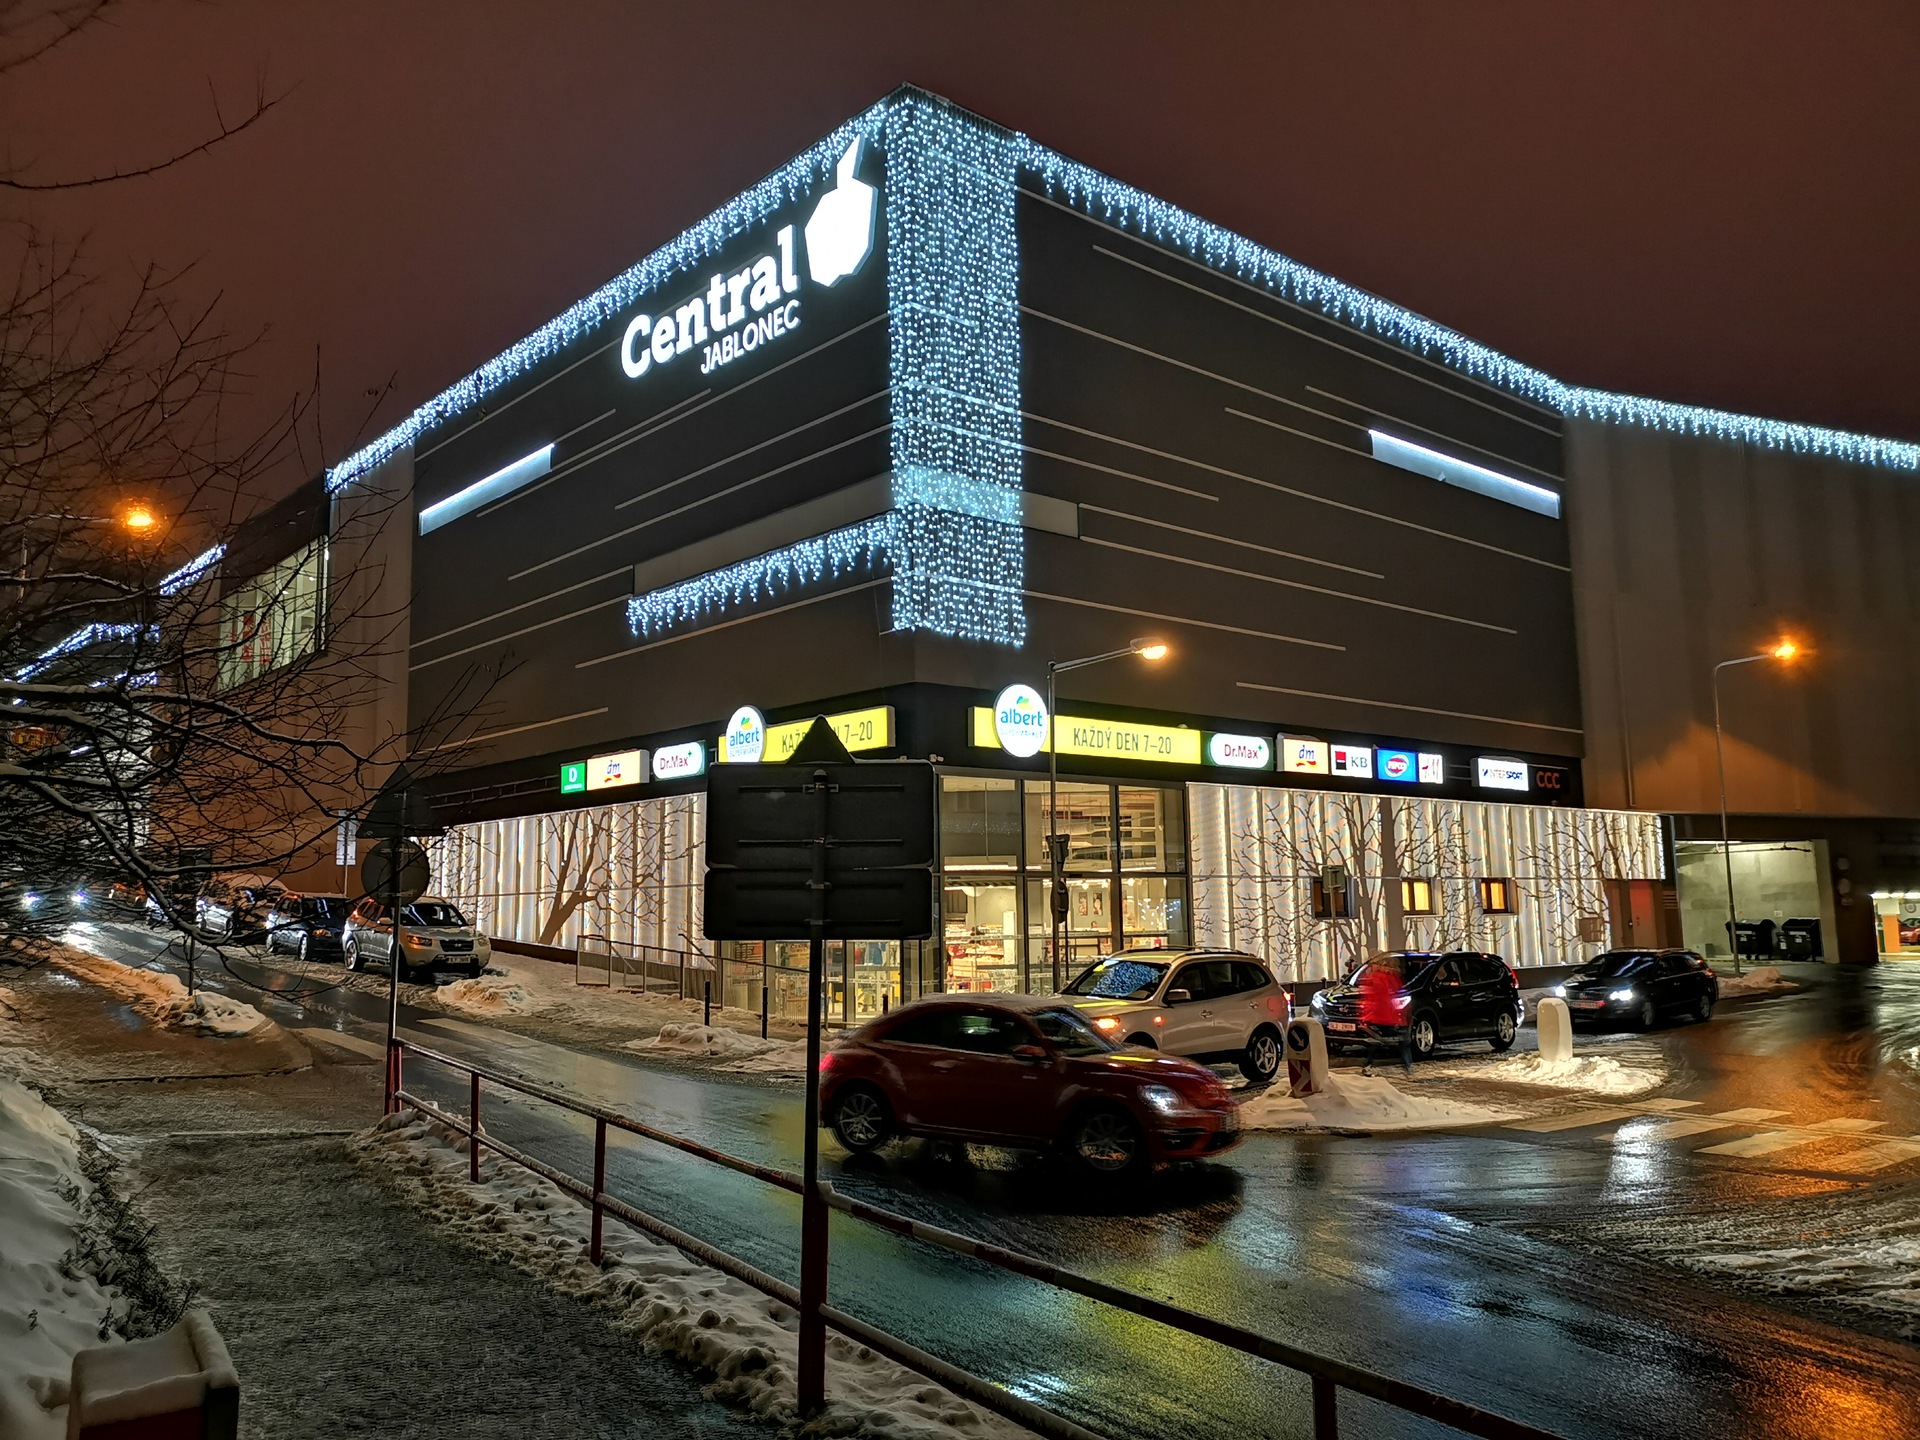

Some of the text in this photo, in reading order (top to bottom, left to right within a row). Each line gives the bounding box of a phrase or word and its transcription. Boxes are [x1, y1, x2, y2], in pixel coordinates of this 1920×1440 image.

[621, 224, 800, 379] Central
[700, 299, 801, 374] JABLONEC
[1000, 708, 1043, 727] albert
[729, 727, 760, 747] albert
[1073, 720, 1112, 749] KAŽDÝ
[1116, 731, 1139, 751] DEN
[1224, 744, 1259, 760] Dr.Max
[1298, 744, 1315, 760] dm
[660, 755, 689, 771] Dr.Max
[1351, 756, 1368, 768] KB
[1536, 770, 1561, 790] CCC
